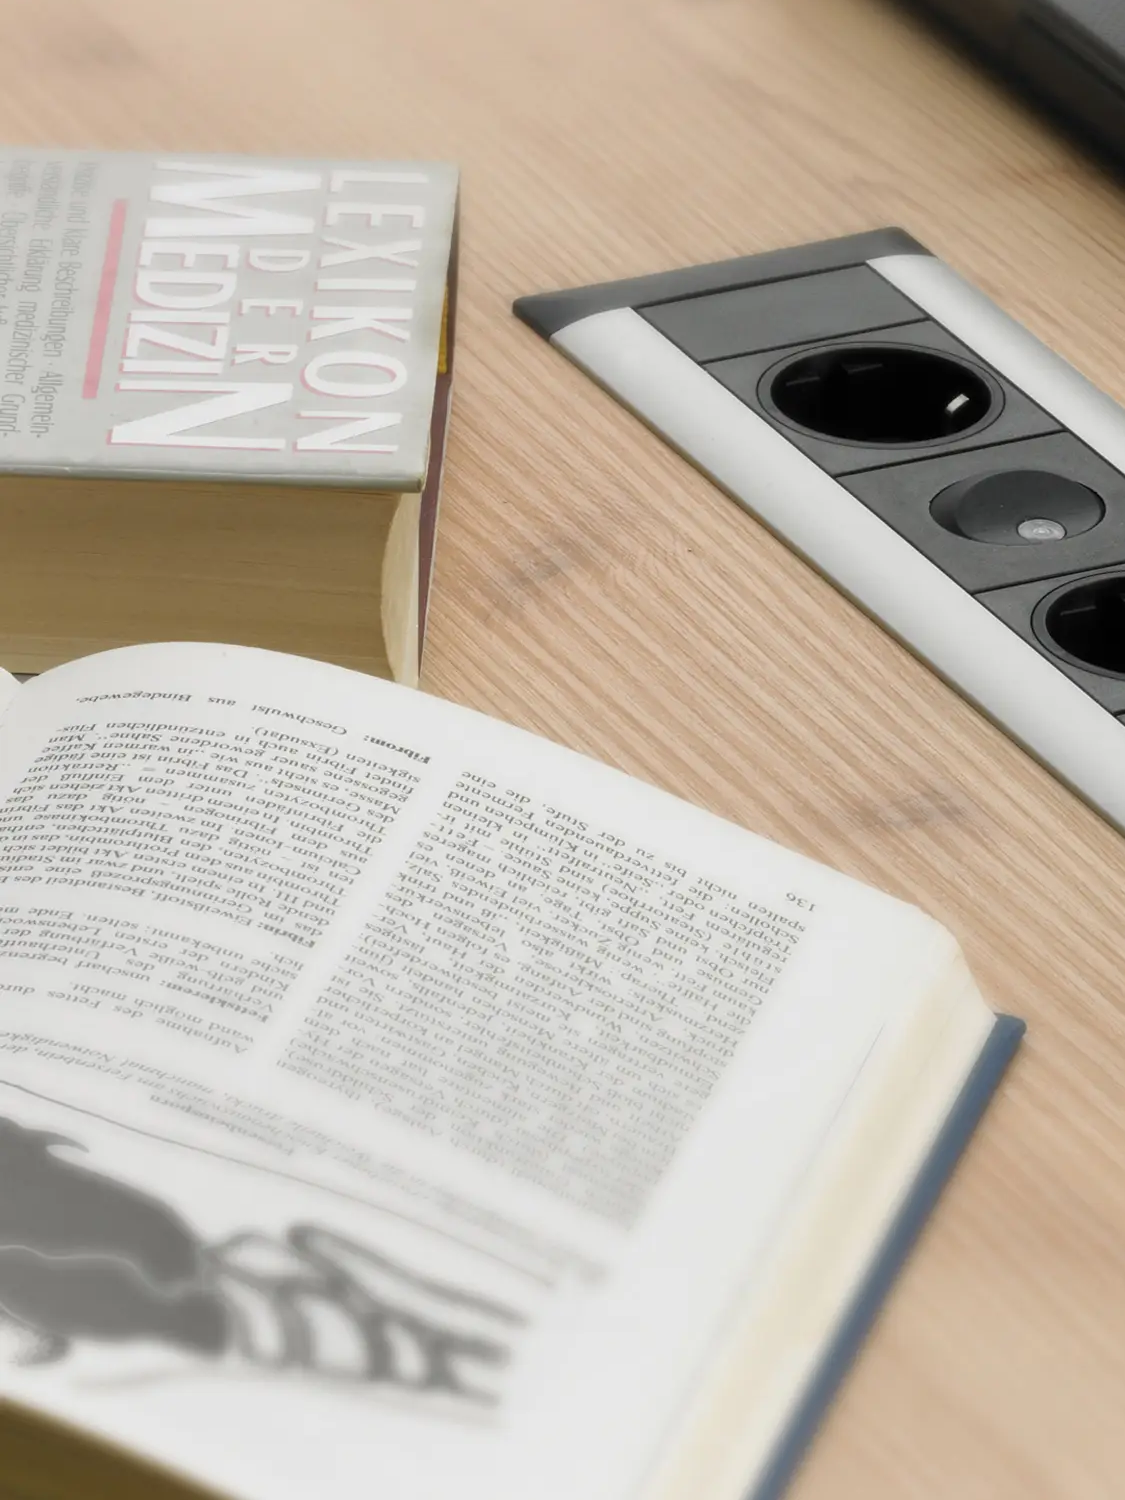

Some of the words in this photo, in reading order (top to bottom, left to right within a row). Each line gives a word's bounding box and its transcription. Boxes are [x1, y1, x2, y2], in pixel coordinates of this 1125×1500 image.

[66, 201, 89, 223] und
[58, 229, 86, 257] klare
[16, 239, 53, 292] Erklärung
[41, 262, 82, 357] Beschreibungen
[107, 161, 322, 451] MEDIZIN
[232, 248, 312, 366] DER
[294, 168, 430, 453] LEXIKON
[3, 301, 39, 386] medizinischer
[29, 371, 63, 439] Allgemein-
[0, 393, 25, 438] Grund-
[76, 690, 191, 702] Bindegewebe.
[208, 697, 235, 705] aus
[251, 704, 346, 734] Geschwulst
[106, 722, 225, 736] entzündlichen
[45, 733, 86, 747] Man
[102, 741, 169, 751] warmen
[169, 732, 266, 757] gewordene
[234, 734, 250, 744] in
[252, 727, 338, 758] (Exsudat).
[37, 742, 97, 758] Kaffee
[90, 752, 126, 760] eine
[131, 753, 151, 761] ist
[255, 740, 298, 760] auch
[363, 735, 430, 764] Fibrom:
[30, 748, 89, 768] fädige
[157, 755, 209, 770] Fibrin
[210, 752, 238, 767] wie
[244, 760, 273, 771] aus
[270, 755, 317, 772] sauer
[302, 752, 357, 778] Fibrin
[215, 764, 248, 778] Das
[346, 753, 420, 782] sigkeiten
[15, 774, 48, 789] der
[57, 772, 124, 783] Einfluß
[138, 776, 174, 788] dem
[165, 768, 255, 790] zusammen
[274, 768, 318, 784] sieht
[360, 772, 413, 796] findet
[461, 771, 496, 787] eine
[12, 784, 45, 794] sich
[49, 782, 105, 791] ziehen
[105, 784, 141, 794] Akt
[186, 782, 231, 796] unter
[321, 782, 339, 790] es
[323, 768, 411, 802] gegossene
[6, 795, 33, 803] das
[47, 792, 87, 801] dazu
[101, 790, 145, 803] nötig
[145, 787, 203, 804] dritten
[341, 788, 400, 814] Masse,
[447, 791, 479, 807] und
[455, 781, 534, 820] Fermente
[505, 789, 530, 803] die
[55, 803, 84, 811] das
[89, 804, 124, 813] Akt
[129, 807, 195, 823] zweiten
[206, 798, 259, 821] einem
[245, 795, 343, 831] Fibrinfäden
[263, 787, 388, 835] Thrombozyten
[33, 814, 167, 832] Thrombokinase
[183, 801, 277, 834] Fibrinogen
[262, 812, 279, 823] In
[366, 809, 394, 822] des
[437, 812, 455, 824] ir-
[442, 801, 502, 831] kleinen
[200, 820, 223, 831] Im
[464, 822, 491, 837] mit
[484, 805, 579, 852] Klümpchen
[11, 834, 28, 842] in
[179, 827, 219, 841] dazu
[286, 819, 372, 855] Thrombin.
[291, 833, 327, 849] dem
[356, 831, 381, 843] die
[430, 823, 478, 847] Fett-
[512, 830, 527, 843] in
[597, 832, 625, 846] der
[3, 844, 36, 852] sich
[39, 845, 89, 855] bildet
[180, 838, 211, 851] den
[228, 837, 271, 858] nötig
[231, 827, 360, 875] Calcium-Ionen.
[423, 830, 491, 863] mageres
[500, 838, 551, 866] Stühle
[545, 819, 678, 885] fettverdauenden
[59, 856, 81, 864] im
[93, 848, 128, 858] Akt
[133, 853, 186, 867] ersten
[184, 851, 221, 865] dem
[340, 850, 367, 863] aus
[583, 849, 598, 862] in
[635, 848, 654, 860] zu
[85, 858, 127, 867] zwar
[225, 862, 253, 874] aus
[300, 861, 319, 873] ist
[664, 862, 686, 877] bis
[13, 875, 42, 883] des
[130, 864, 164, 878] und
[191, 865, 243, 883] einem
[328, 870, 353, 884] ten
[558, 865, 593, 883] sind
[45, 877, 145, 896] Bestandteil
[248, 881, 265, 892] In
[256, 871, 338, 906] Thrombin
[498, 862, 567, 901] reichlich
[556, 876, 600, 902] keine
[697, 877, 736, 899] nicht
[226, 888, 271, 907] Rolle
[667, 890, 704, 909] oder
[688, 886, 712, 900] die
[302, 900, 335, 915] und
[785, 892, 817, 912] 136
[278, 904, 329, 925] dende
[601, 884, 716, 941] (Steatorrhoe)
[748, 902, 805, 931] spalten
[617, 918, 649, 937] Saft
[709, 909, 790, 955] Tröpfchen
[655, 936, 686, 954] und
[664, 927, 708, 953] keine
[705, 920, 789, 962] regulärem
[695, 955, 733, 977] Obst
[723, 943, 781, 973] stühle
[742, 978, 768, 993] nur
